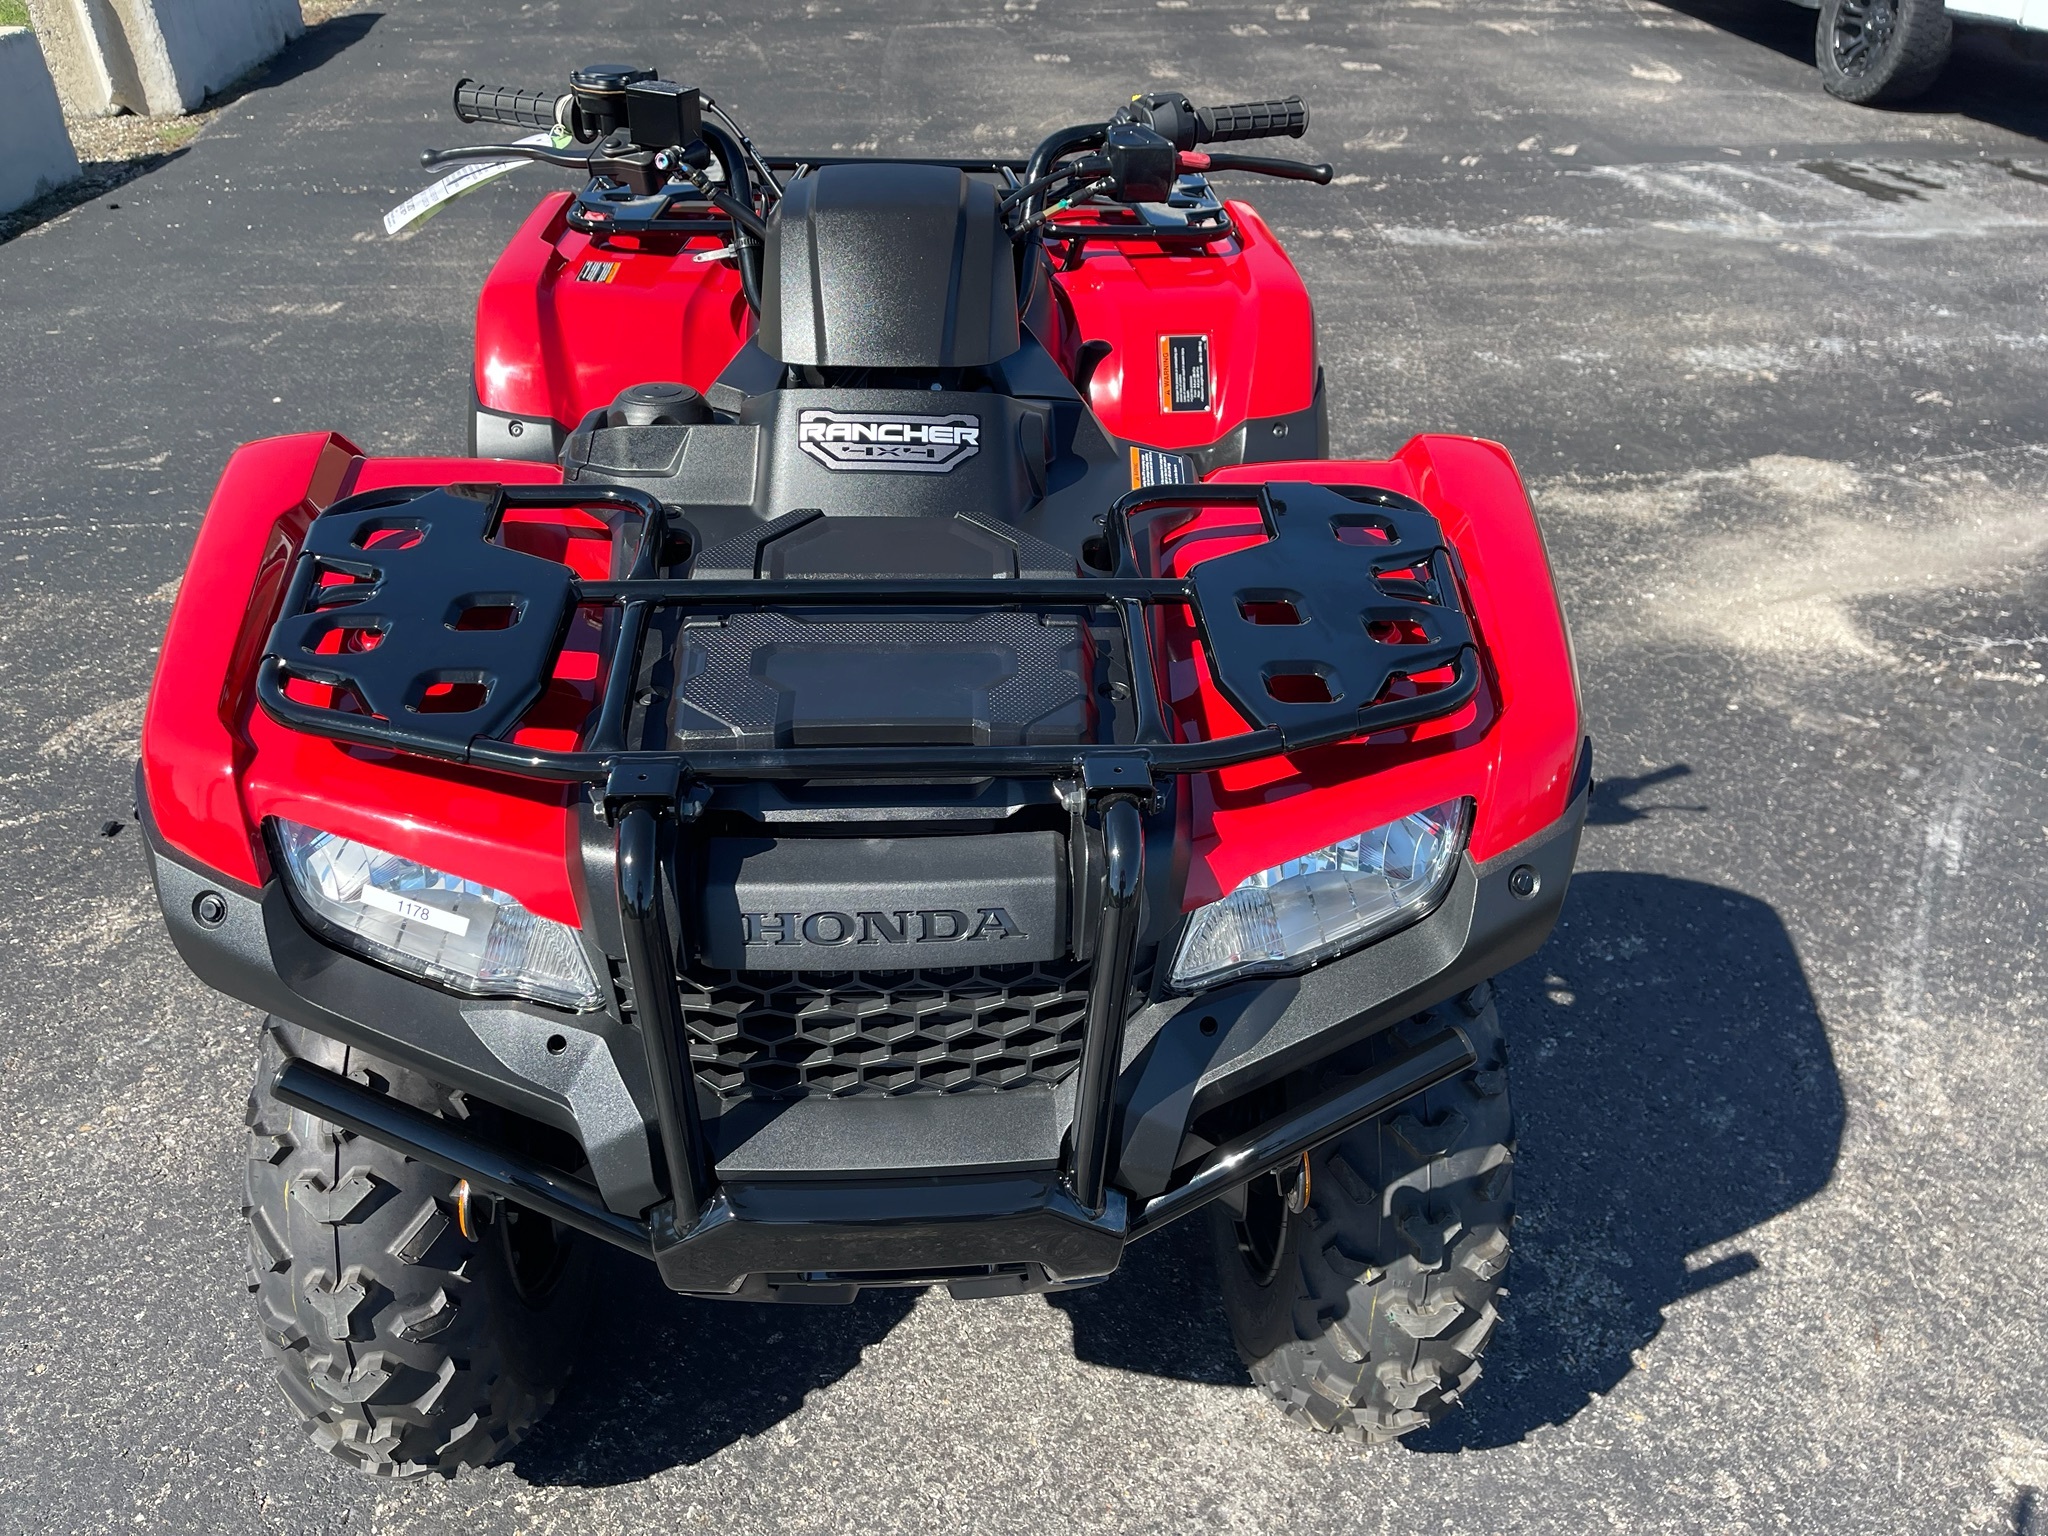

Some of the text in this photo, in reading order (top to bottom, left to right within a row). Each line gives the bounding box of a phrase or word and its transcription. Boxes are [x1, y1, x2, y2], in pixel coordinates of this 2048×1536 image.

[800, 423, 979, 445] RANCHER
[842, 447, 935, 458] 4X4
[398, 900, 430, 921] 1178
[742, 908, 1028, 947] HONDA
